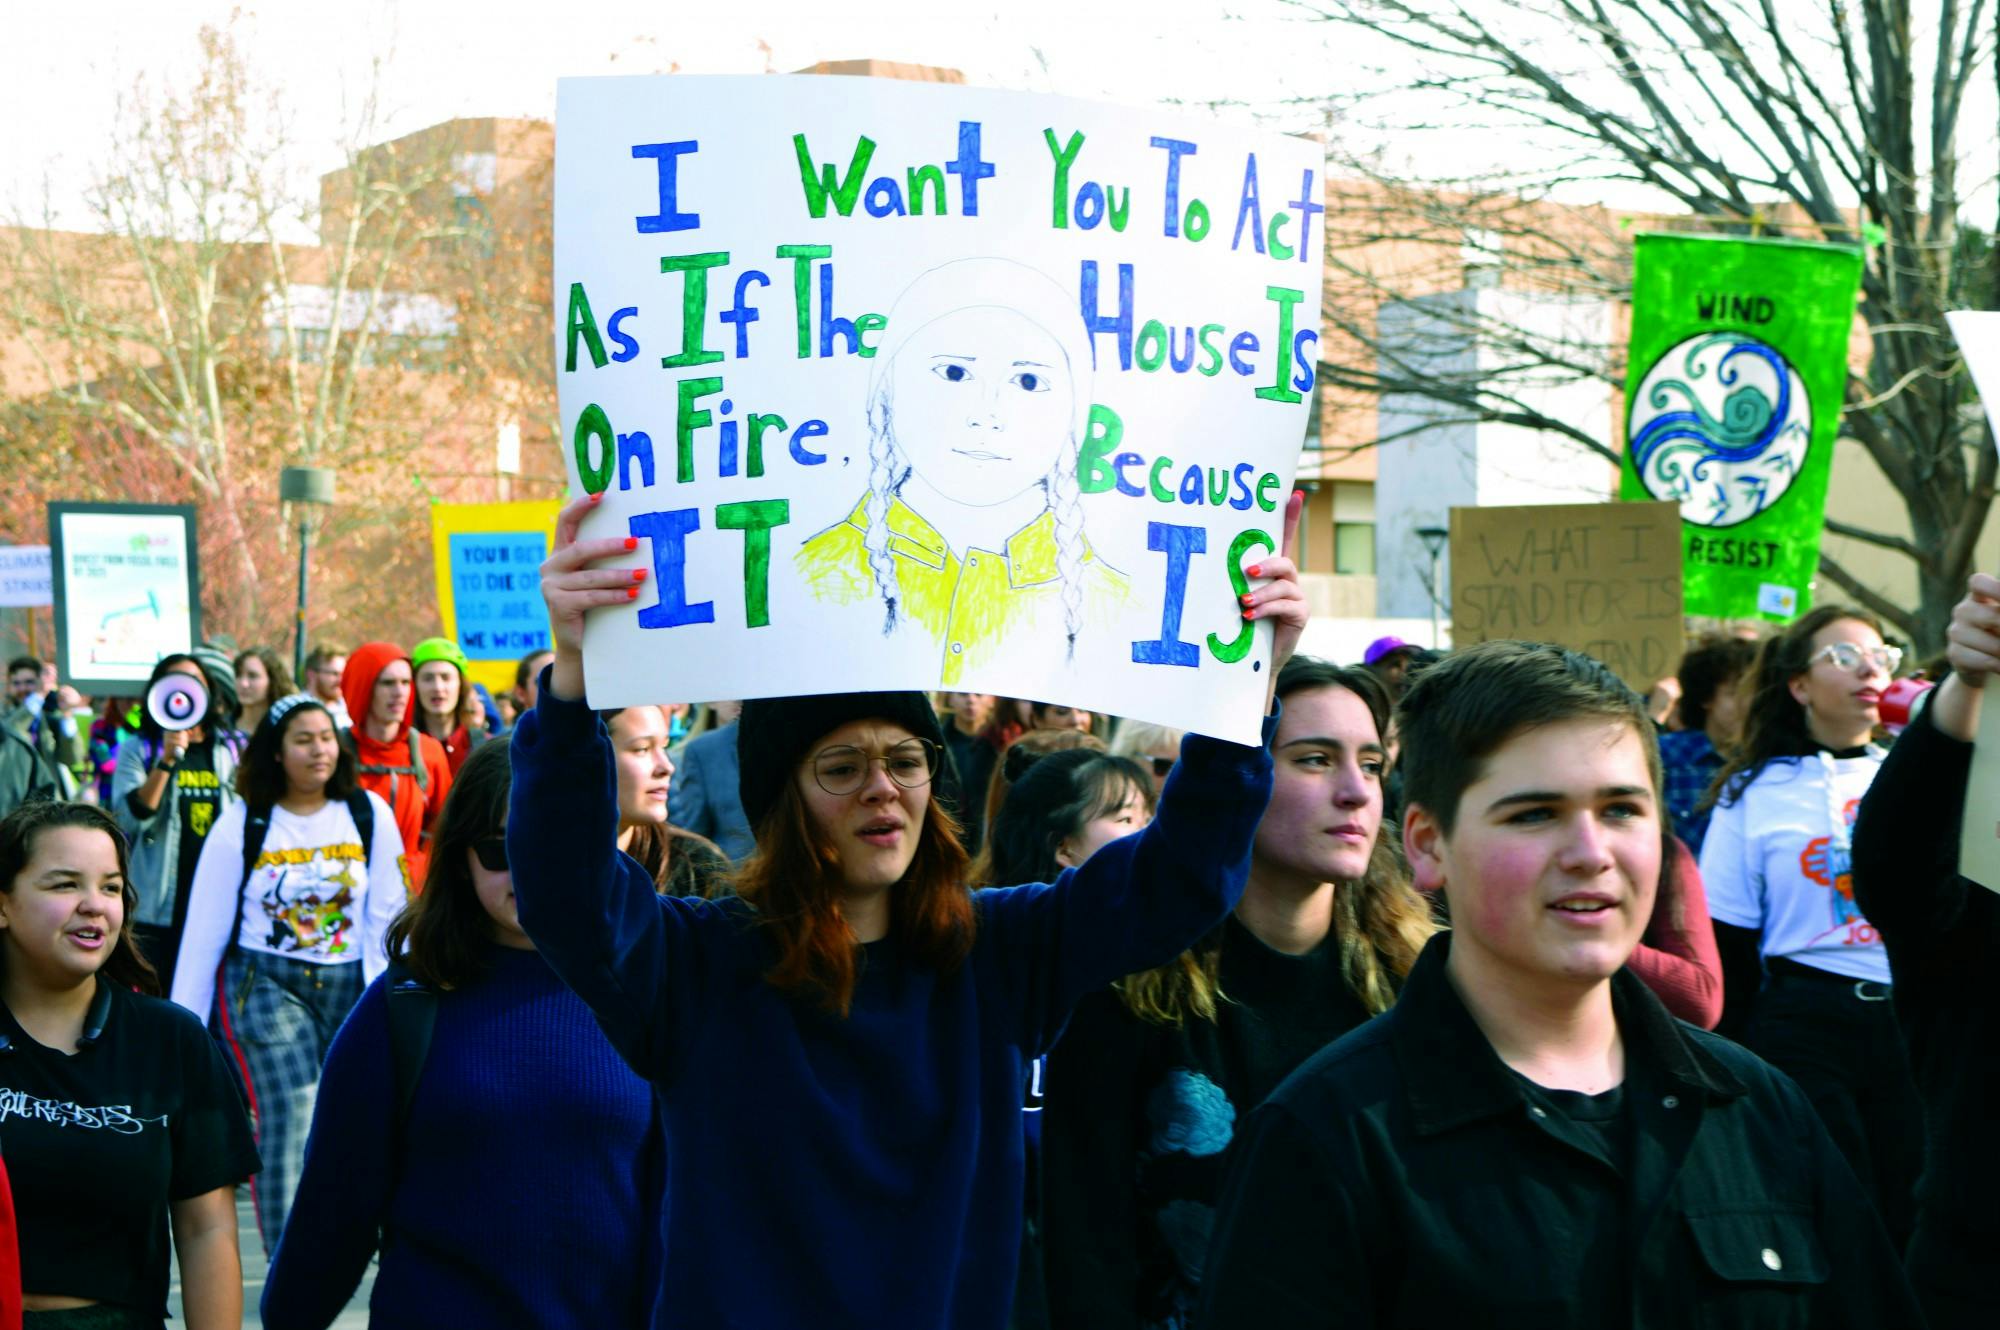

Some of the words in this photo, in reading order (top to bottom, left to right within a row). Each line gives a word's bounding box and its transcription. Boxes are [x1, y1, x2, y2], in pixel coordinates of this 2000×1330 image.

[632, 139, 700, 233] I
[792, 121, 995, 219] Want
[1043, 127, 1131, 233] You
[1150, 136, 1211, 243] To
[1231, 152, 1324, 263] Act
[565, 282, 640, 372] As
[660, 251, 771, 369] If
[776, 244, 888, 360] The
[1080, 259, 1257, 378] House
[1255, 284, 1319, 405] Is
[1695, 292, 1776, 325] WIND
[574, 403, 657, 495] On
[677, 376, 851, 483] Fire,
[1077, 403, 1282, 514] Because
[629, 499, 790, 630] IT
[1480, 525, 1600, 577] WHAT
[1618, 523, 1655, 565] I
[1689, 535, 1780, 568] RESIST
[486, 572, 515, 592] DIE
[1633, 573, 1682, 620] IS
